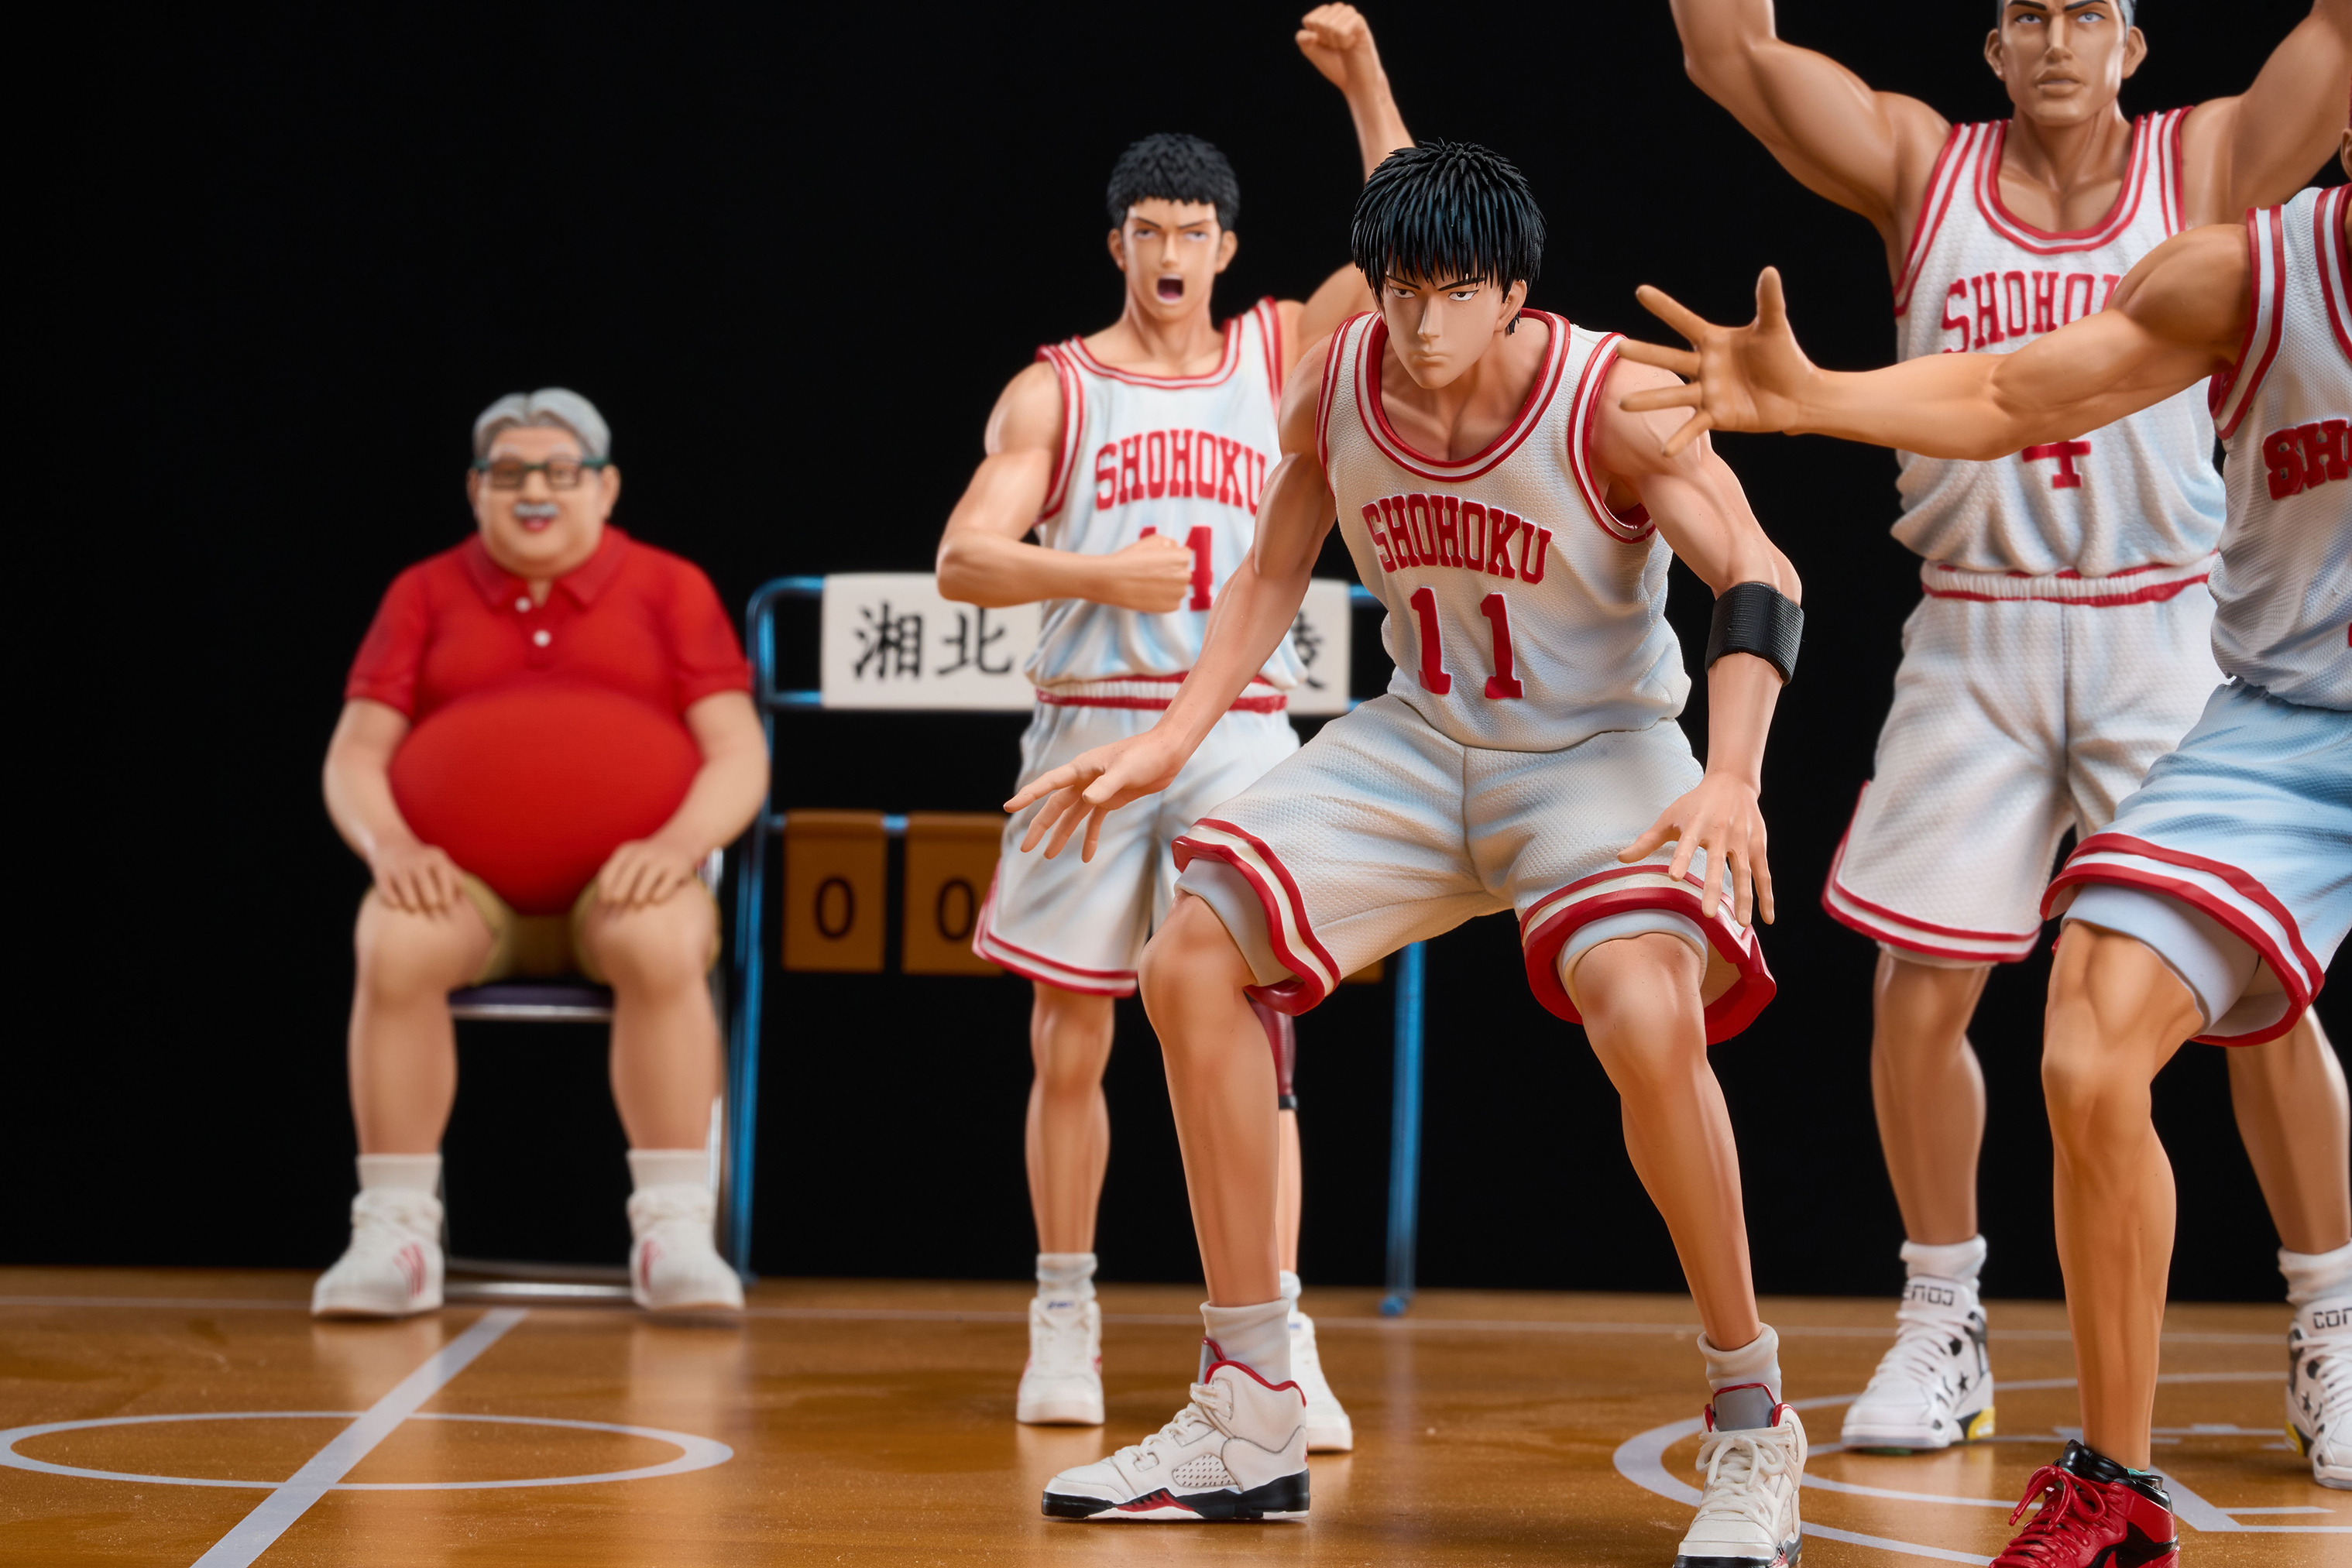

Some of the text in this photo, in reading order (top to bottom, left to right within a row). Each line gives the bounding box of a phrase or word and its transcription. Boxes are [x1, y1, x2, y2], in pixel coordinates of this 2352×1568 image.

[1941, 270, 2120, 354] SHOHO
[1095, 428, 1266, 517] SHOHOKU
[2262, 419, 2352, 501] SH
[1361, 492, 1552, 585] SHOHOKU
[854, 600, 1015, 680] 湘北
[1410, 586, 1524, 699] 11
[815, 877, 975, 942] 0 0
